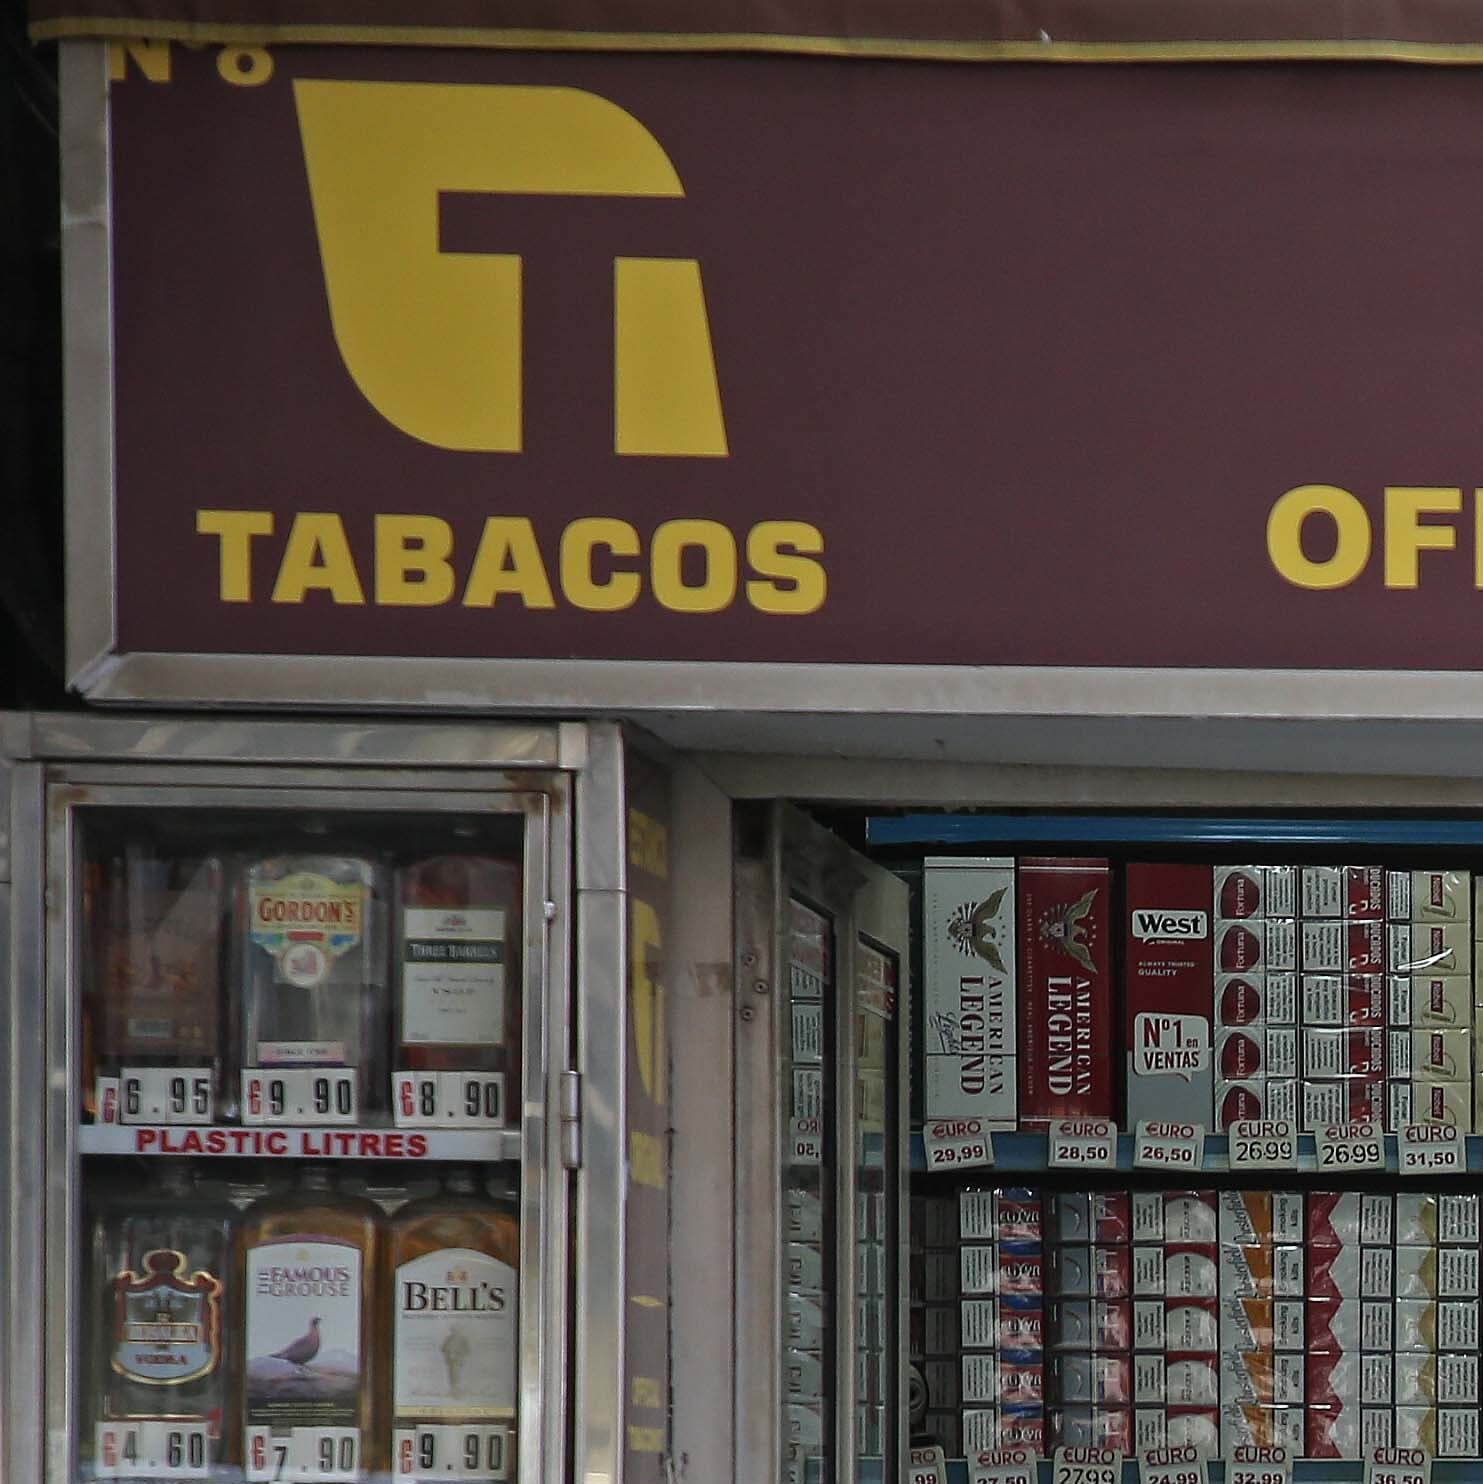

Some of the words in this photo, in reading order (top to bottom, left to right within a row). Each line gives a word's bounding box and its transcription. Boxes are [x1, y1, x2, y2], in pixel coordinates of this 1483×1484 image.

[197, 510, 827, 616] TABACOS
[1138, 914, 1202, 936] West
[959, 976, 985, 1096] LEGEND
[1047, 976, 1072, 1096] LEGEND
[1143, 1050, 1200, 1071] VENTAS
[135, 1129, 288, 1155] PLASTIC
[302, 1130, 428, 1157] LITRES
[1058, 1145, 1108, 1161] 28,50
[1142, 1146, 1192, 1163] 26,50
[1406, 1150, 1456, 1167] 31,50
[403, 1280, 505, 1312] BELL'S
